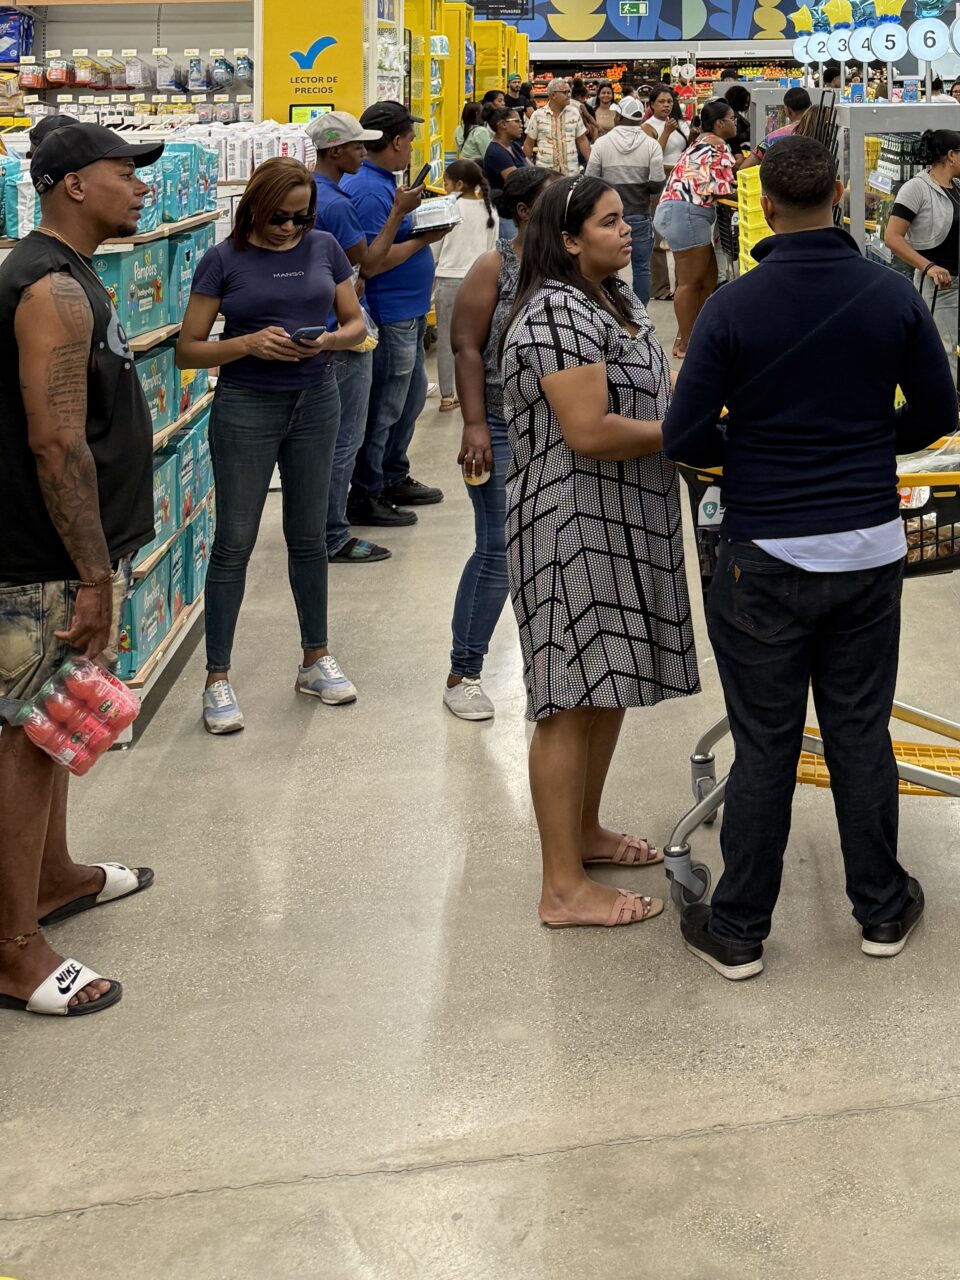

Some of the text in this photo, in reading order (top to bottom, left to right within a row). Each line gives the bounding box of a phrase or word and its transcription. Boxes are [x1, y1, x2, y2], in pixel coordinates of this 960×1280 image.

[838, 38, 847, 52] 3
[861, 37, 871, 51] 4
[884, 34, 896, 50] 5
[923, 29, 937, 49] 6
[817, 41, 826, 53] 2
[290, 76, 324, 84] LECTOR
[294, 86, 334, 94] PRECIOS
[134, 261, 158, 281] Pampers
[55, 963, 80, 985] NIKE
